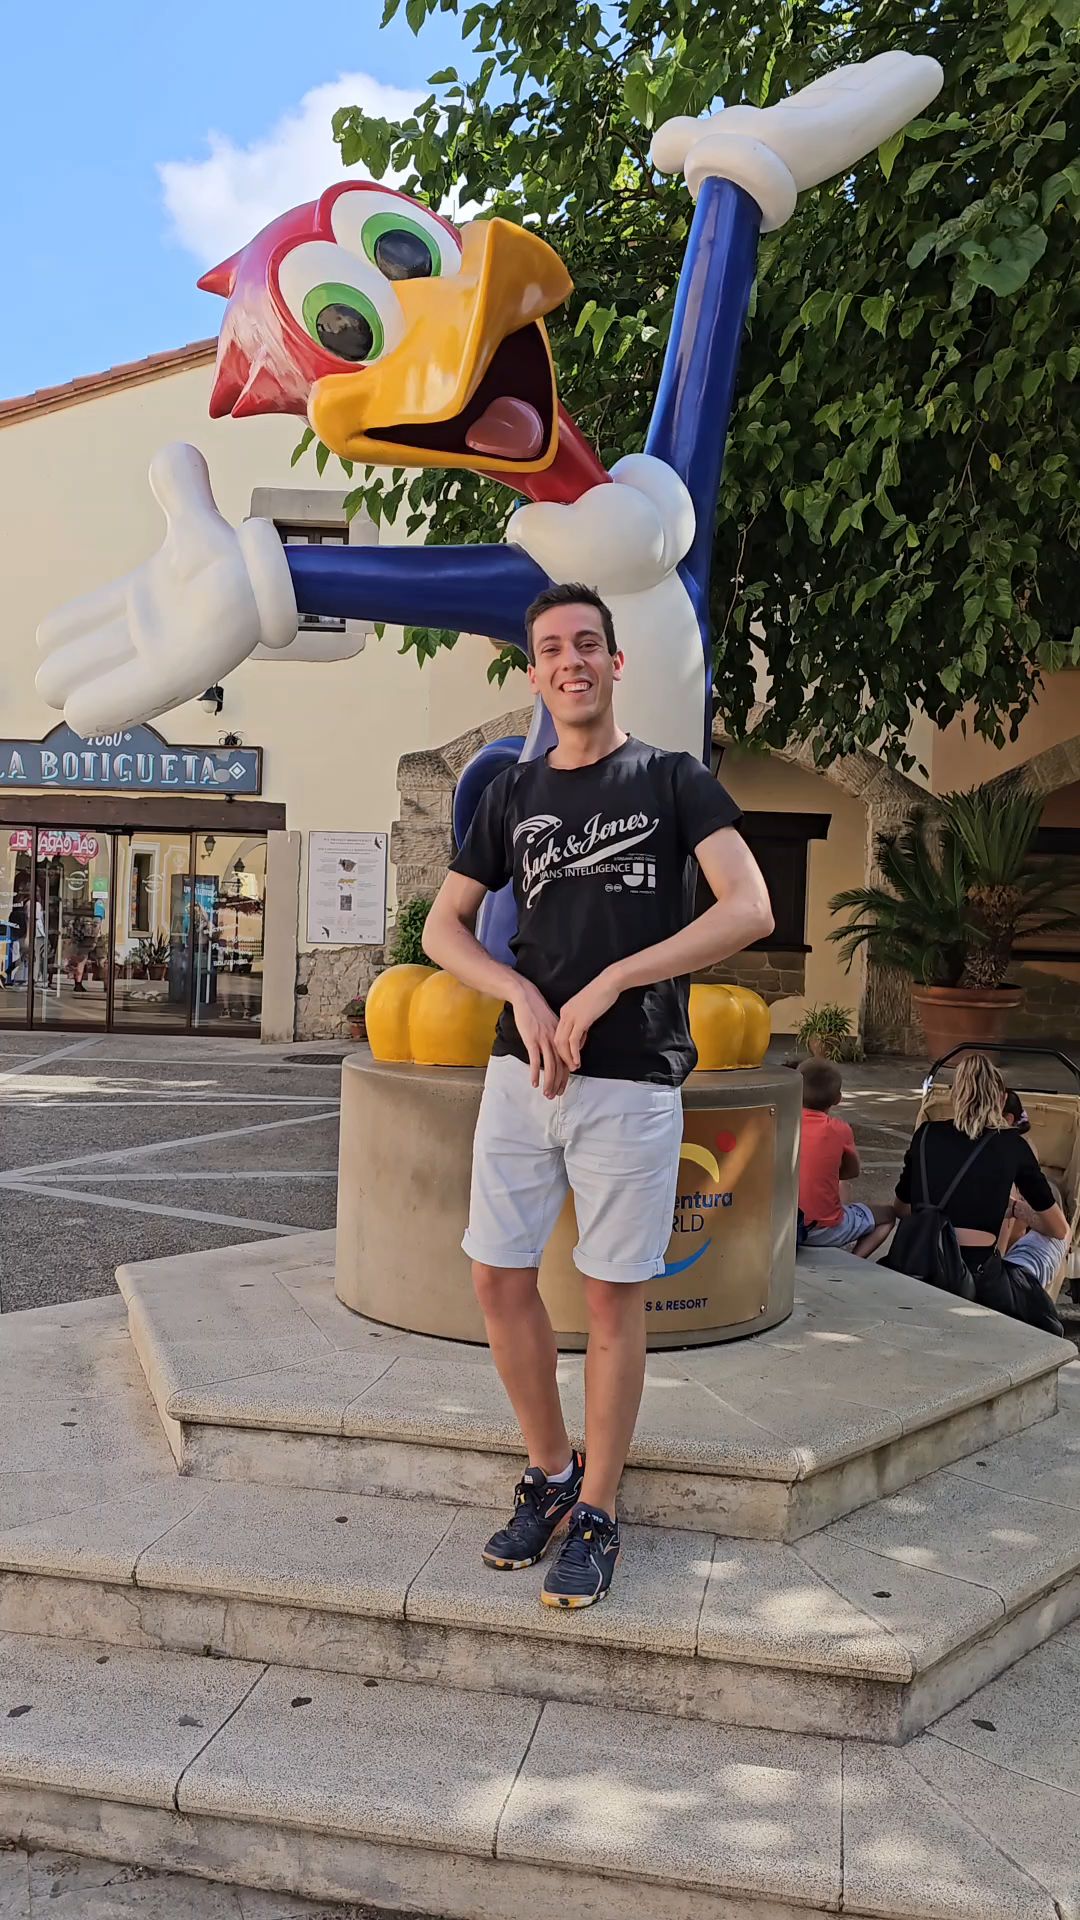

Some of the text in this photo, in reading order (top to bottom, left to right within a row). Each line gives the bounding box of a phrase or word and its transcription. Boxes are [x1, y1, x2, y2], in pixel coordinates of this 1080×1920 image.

[0, 750, 219, 785] A BOTIGUETA
[522, 811, 648, 892] Jack & Jones
[565, 863, 631, 878] INTELLIGENCE
[674, 1191, 733, 1209] entura
[672, 1214, 704, 1233] RLD
[644, 1297, 709, 1312] S & RESORT
